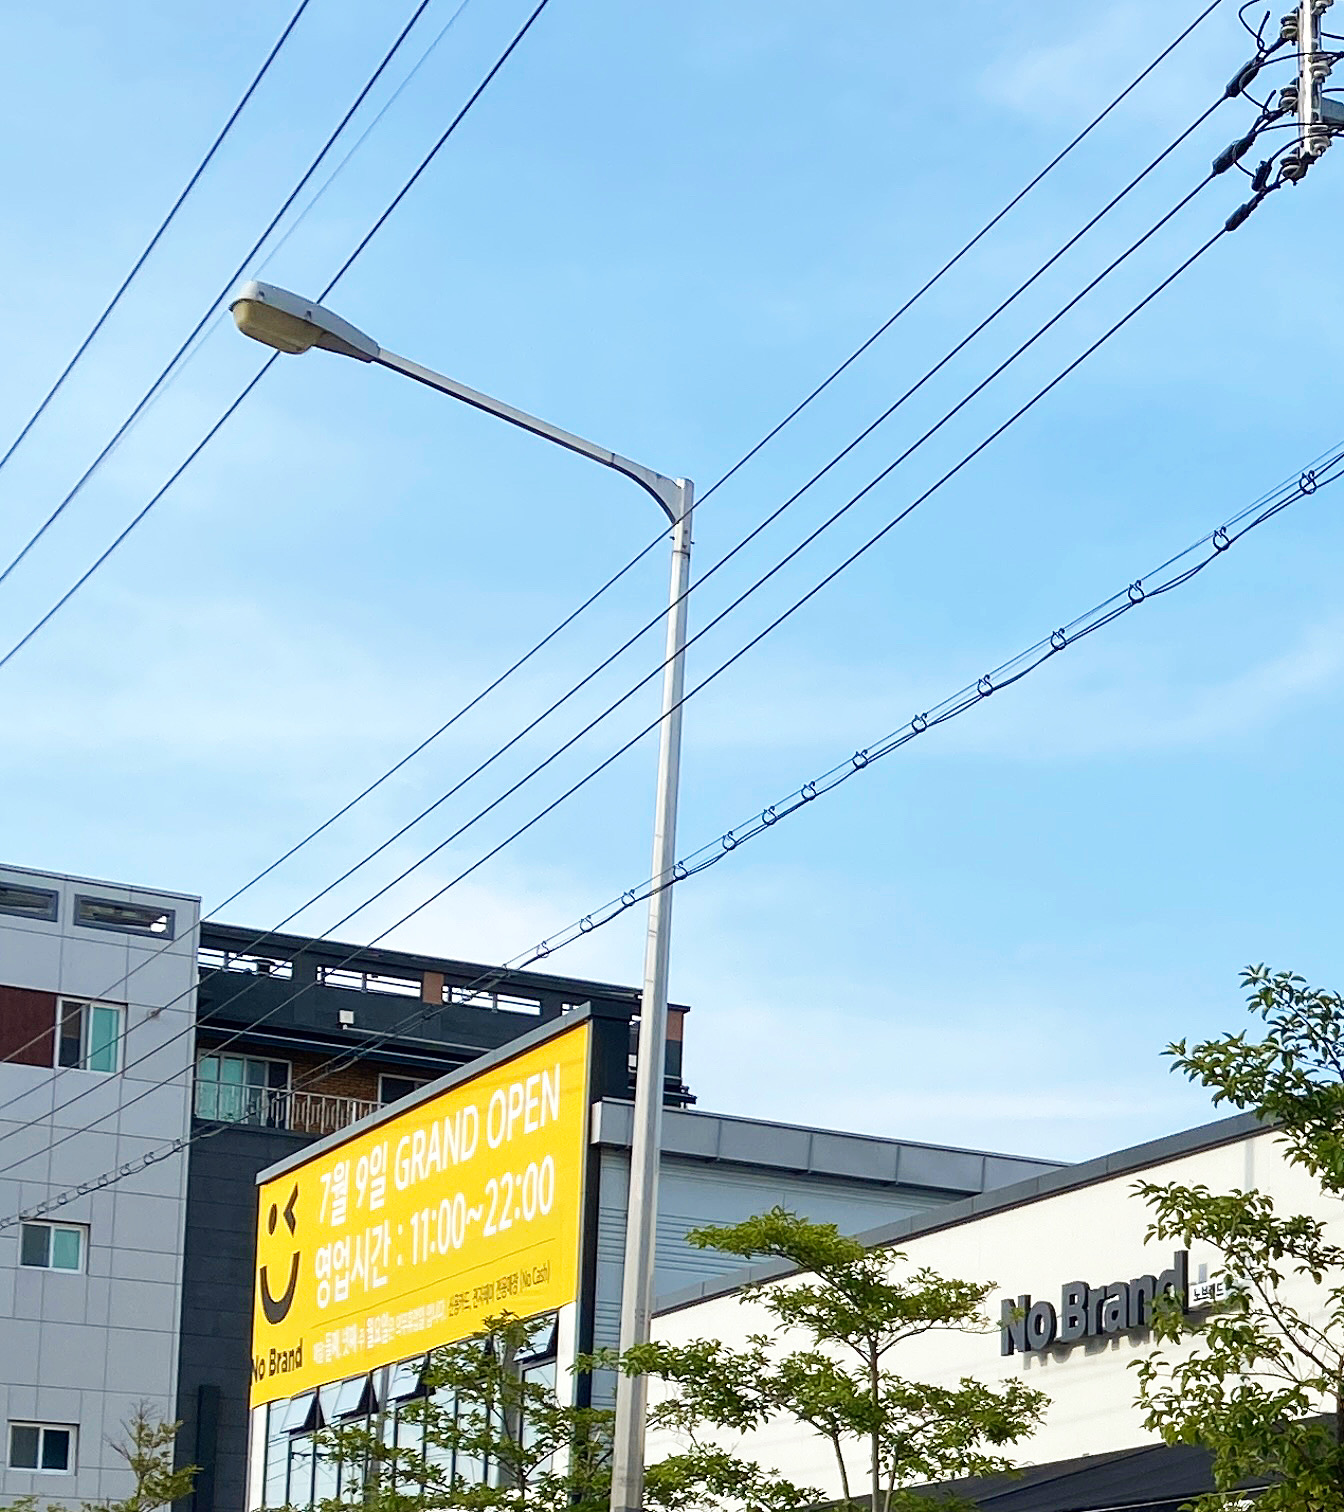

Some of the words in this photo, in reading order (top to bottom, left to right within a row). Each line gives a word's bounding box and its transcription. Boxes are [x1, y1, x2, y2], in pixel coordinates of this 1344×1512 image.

[318, 1161, 350, 1228] 7월
[355, 1143, 388, 1212] 9일
[394, 1106, 479, 1191] GRAND
[486, 1063, 560, 1150] OPEN
[314, 1219, 392, 1309] 영업시간
[410, 1155, 555, 1267] 11:00~22:00
[269, 1337, 304, 1378] Brand
[1001, 1294, 1057, 1356] No
[1061, 1250, 1189, 1344] Brand
